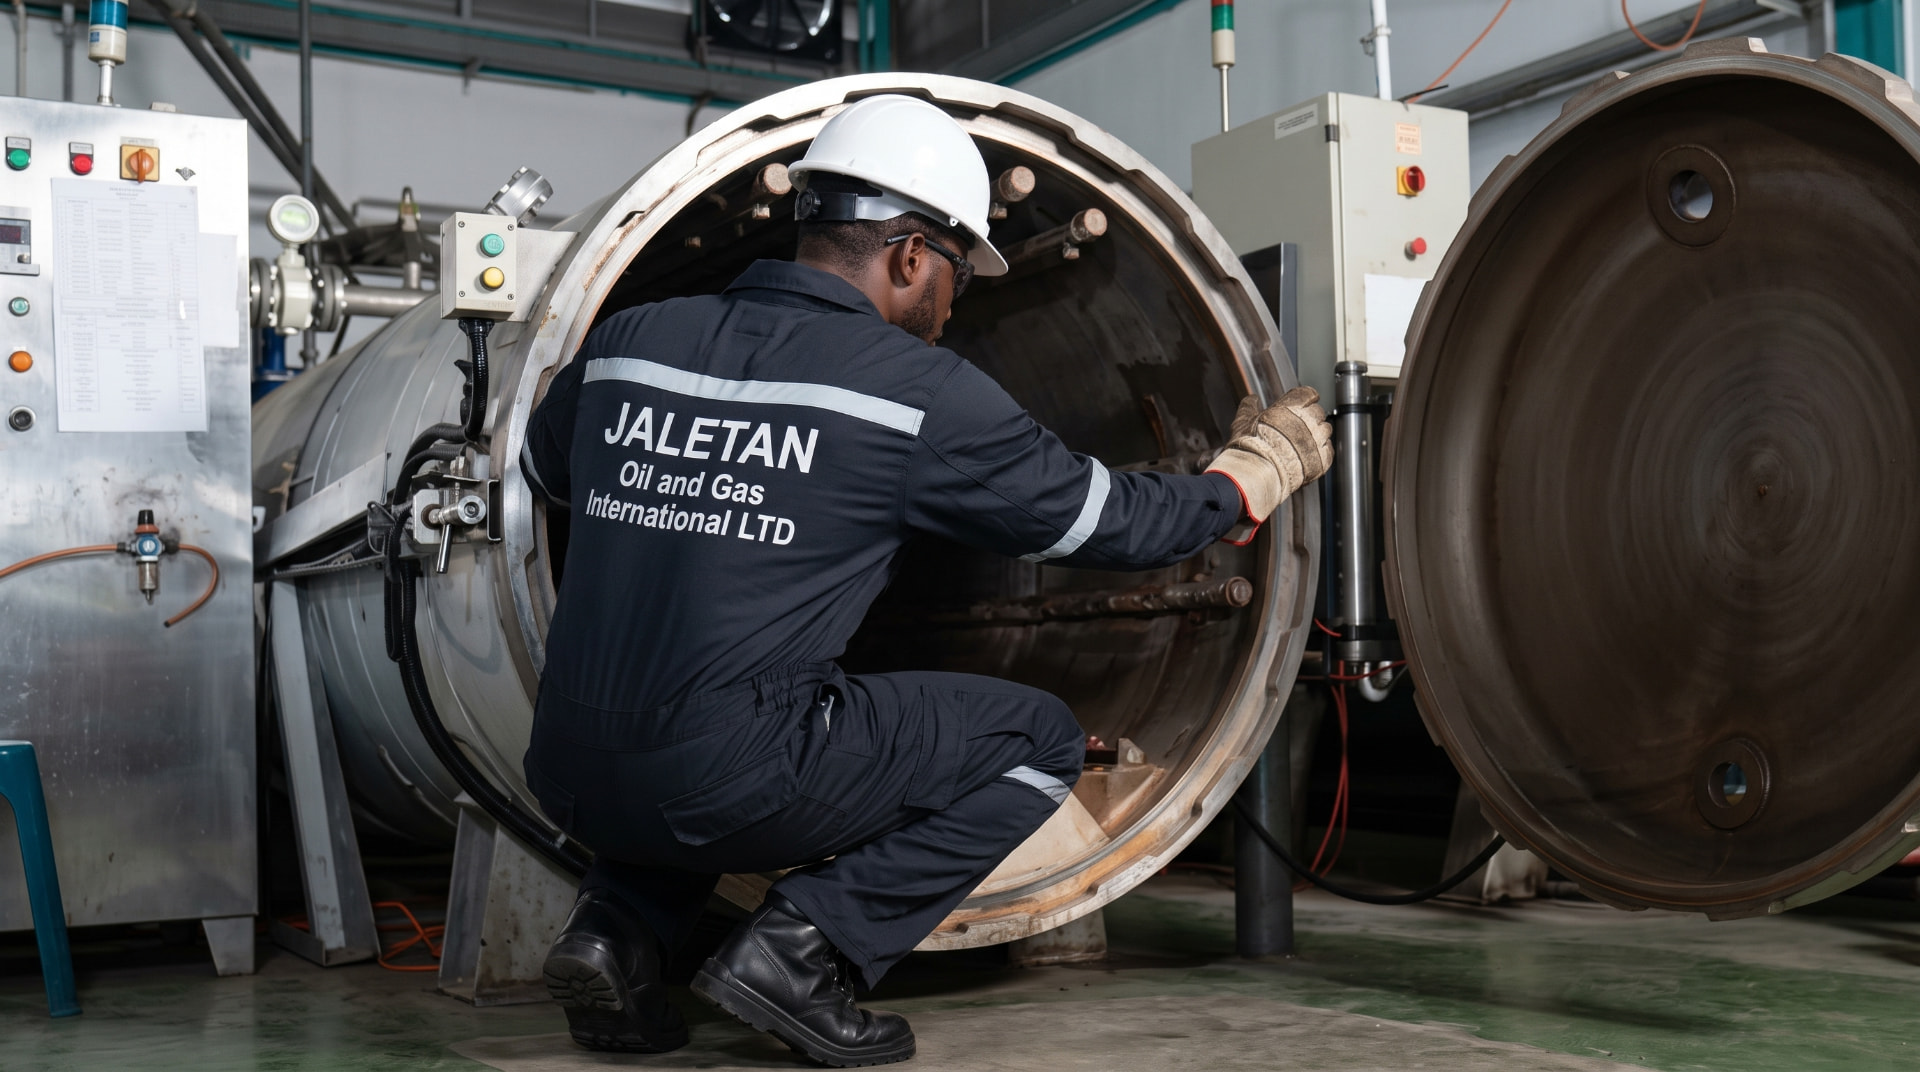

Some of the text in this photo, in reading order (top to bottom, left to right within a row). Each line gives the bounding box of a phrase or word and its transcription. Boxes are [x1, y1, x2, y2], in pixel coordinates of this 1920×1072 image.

[604, 402, 819, 474] JALETAN
[619, 461, 765, 505] Oil and Gas
[586, 489, 796, 546] International LTD
